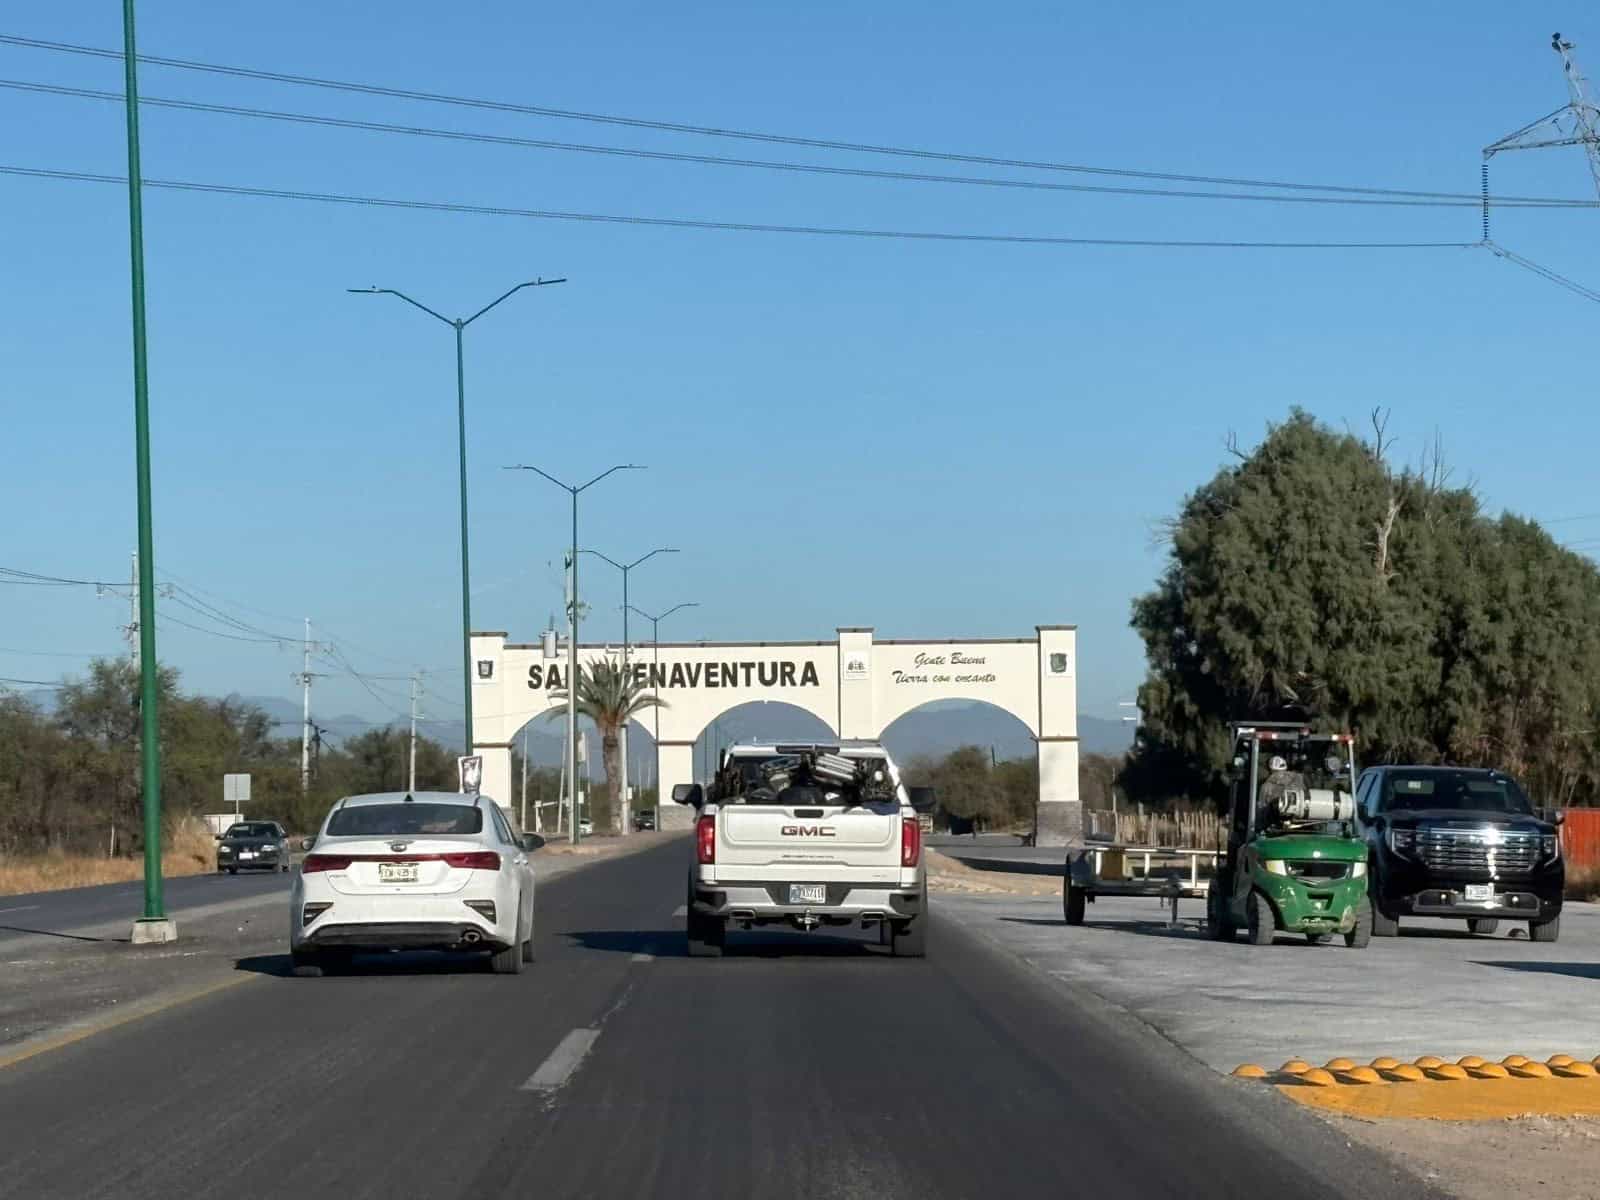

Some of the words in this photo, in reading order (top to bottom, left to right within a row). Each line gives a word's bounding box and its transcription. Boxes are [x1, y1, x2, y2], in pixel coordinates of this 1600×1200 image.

[914, 652, 946, 669] Gente
[951, 652, 986, 665] Buena
[892, 670, 928, 684] Tierra
[932, 674, 951, 683] con
[954, 673, 996, 684] encanto
[781, 825, 836, 837] GMC
